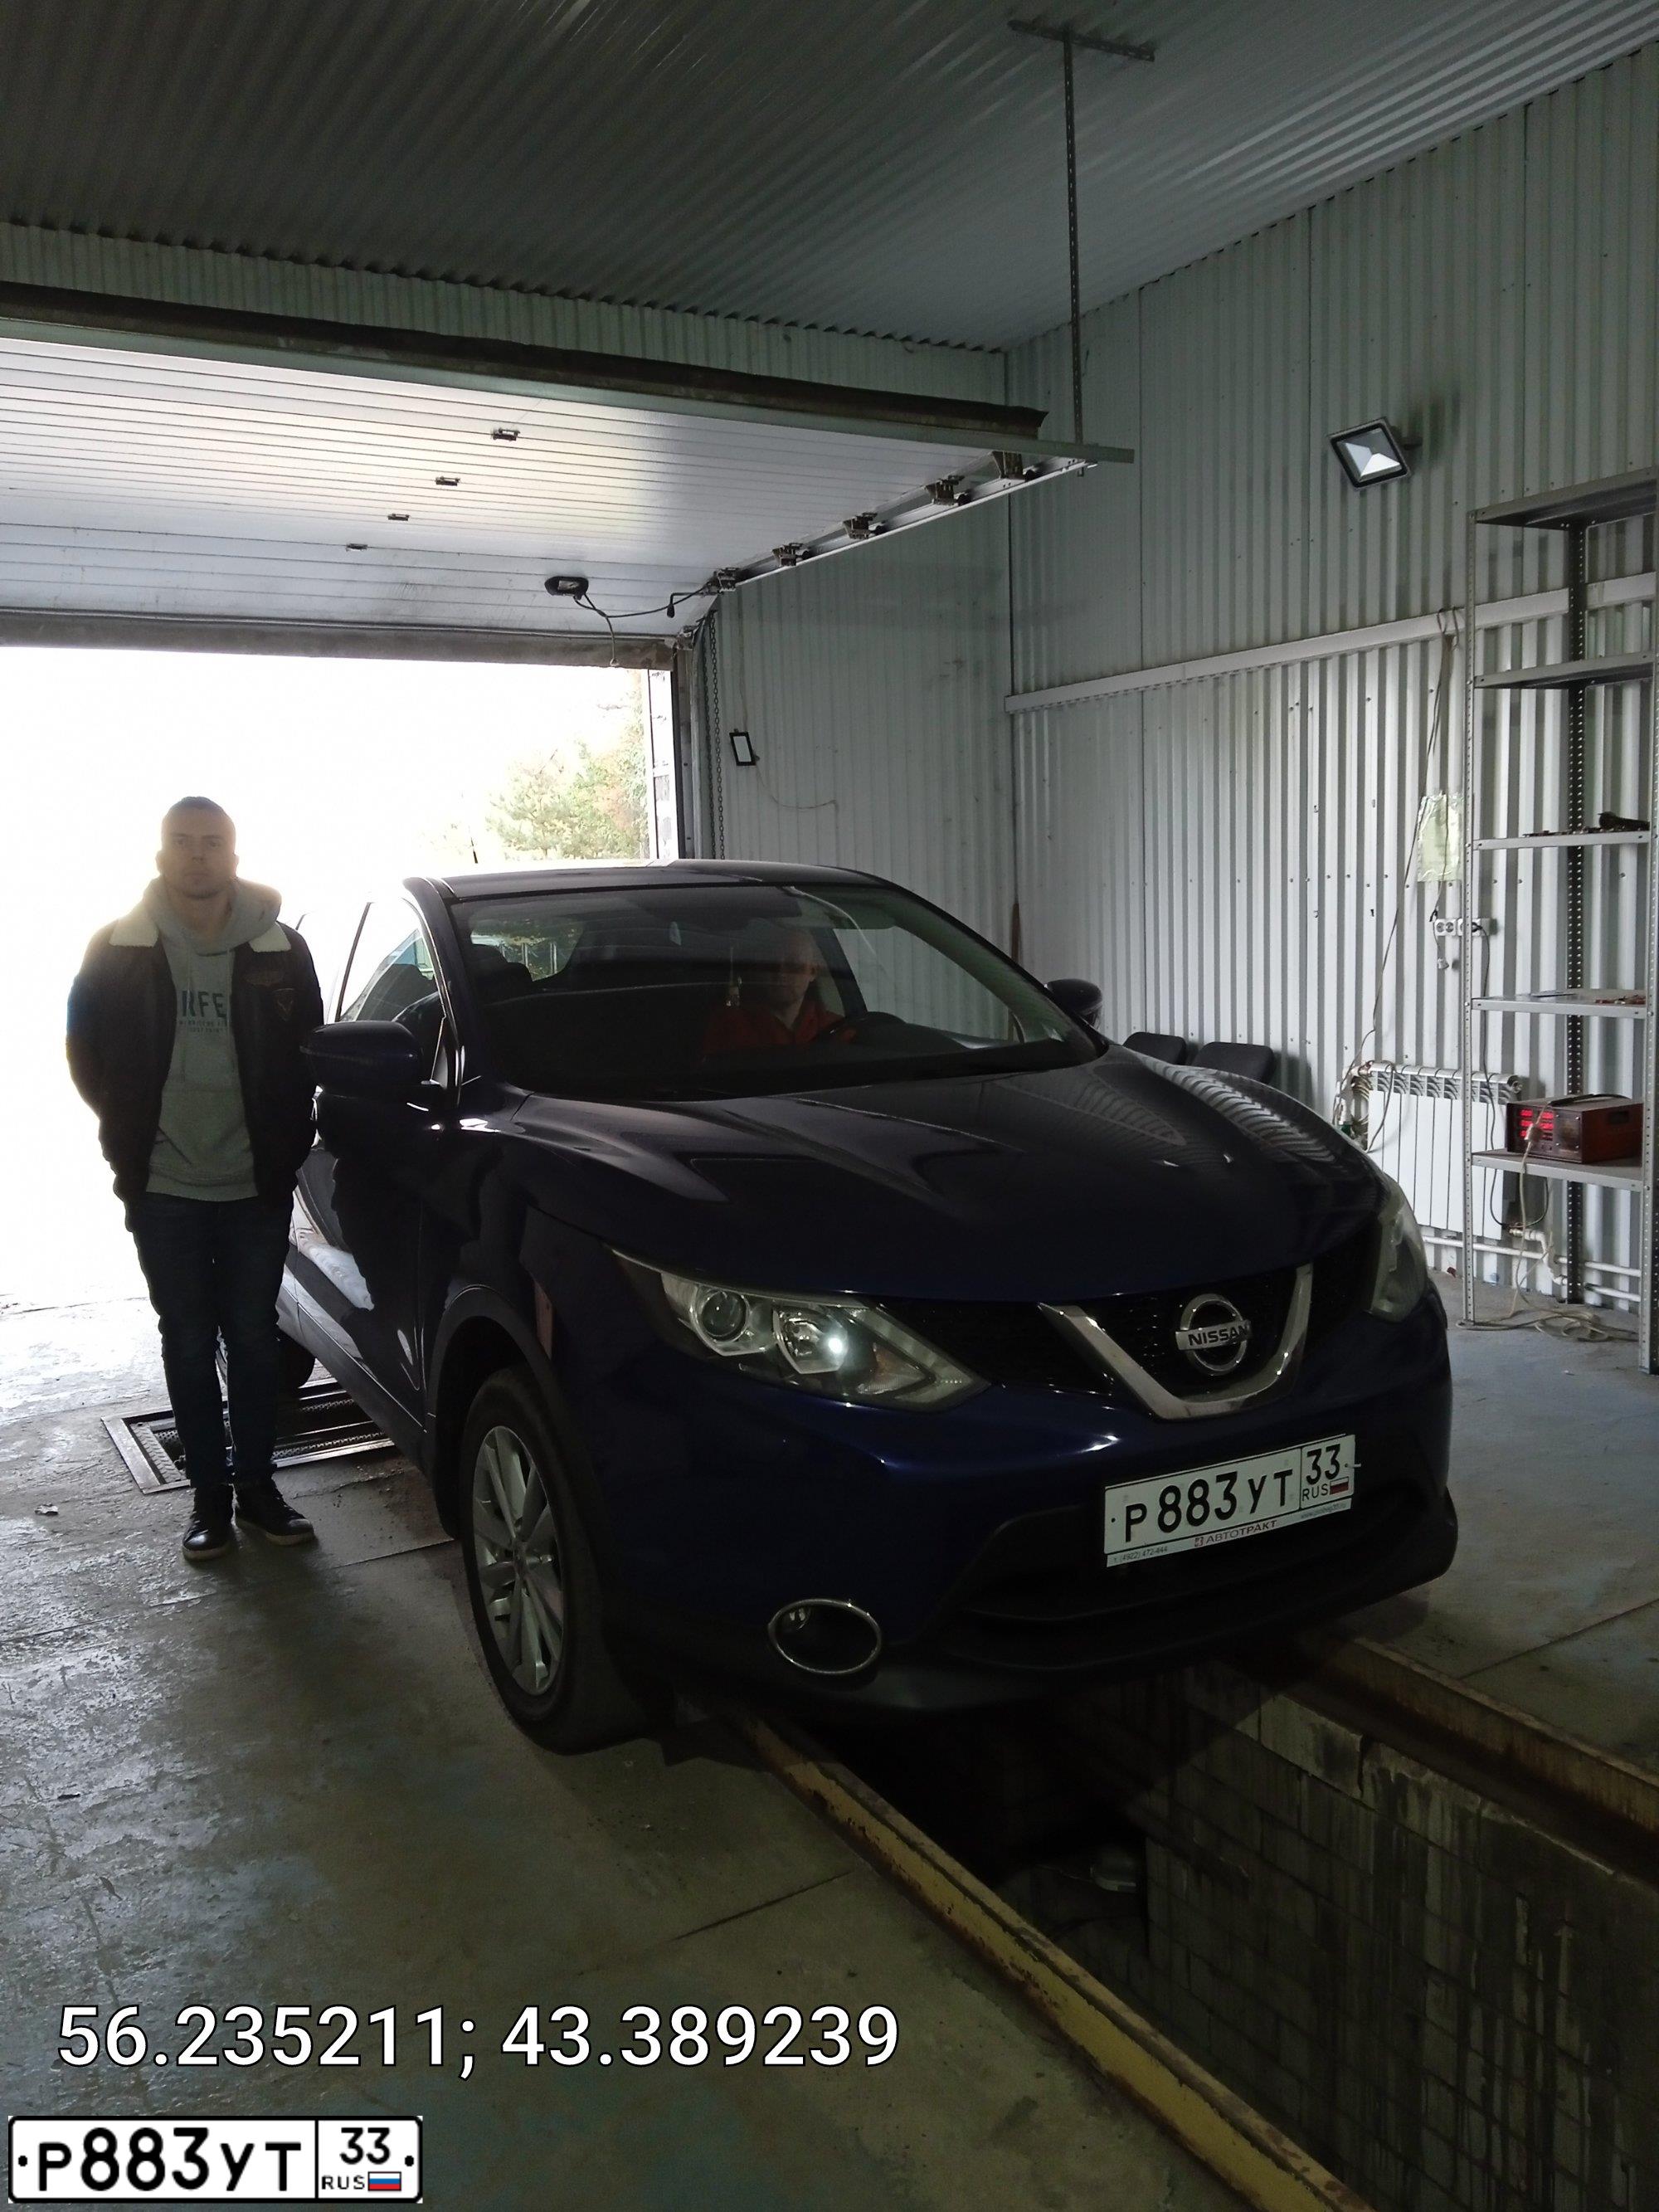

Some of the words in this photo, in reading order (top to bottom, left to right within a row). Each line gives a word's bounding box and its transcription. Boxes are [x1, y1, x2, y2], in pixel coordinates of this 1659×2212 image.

[1188, 1325, 1248, 1346] NISSAN
[1306, 1444, 1341, 1485] 33
[1301, 1486, 1329, 1502] RUS
[1205, 1519, 1278, 1545] АВТОТРАКТ
